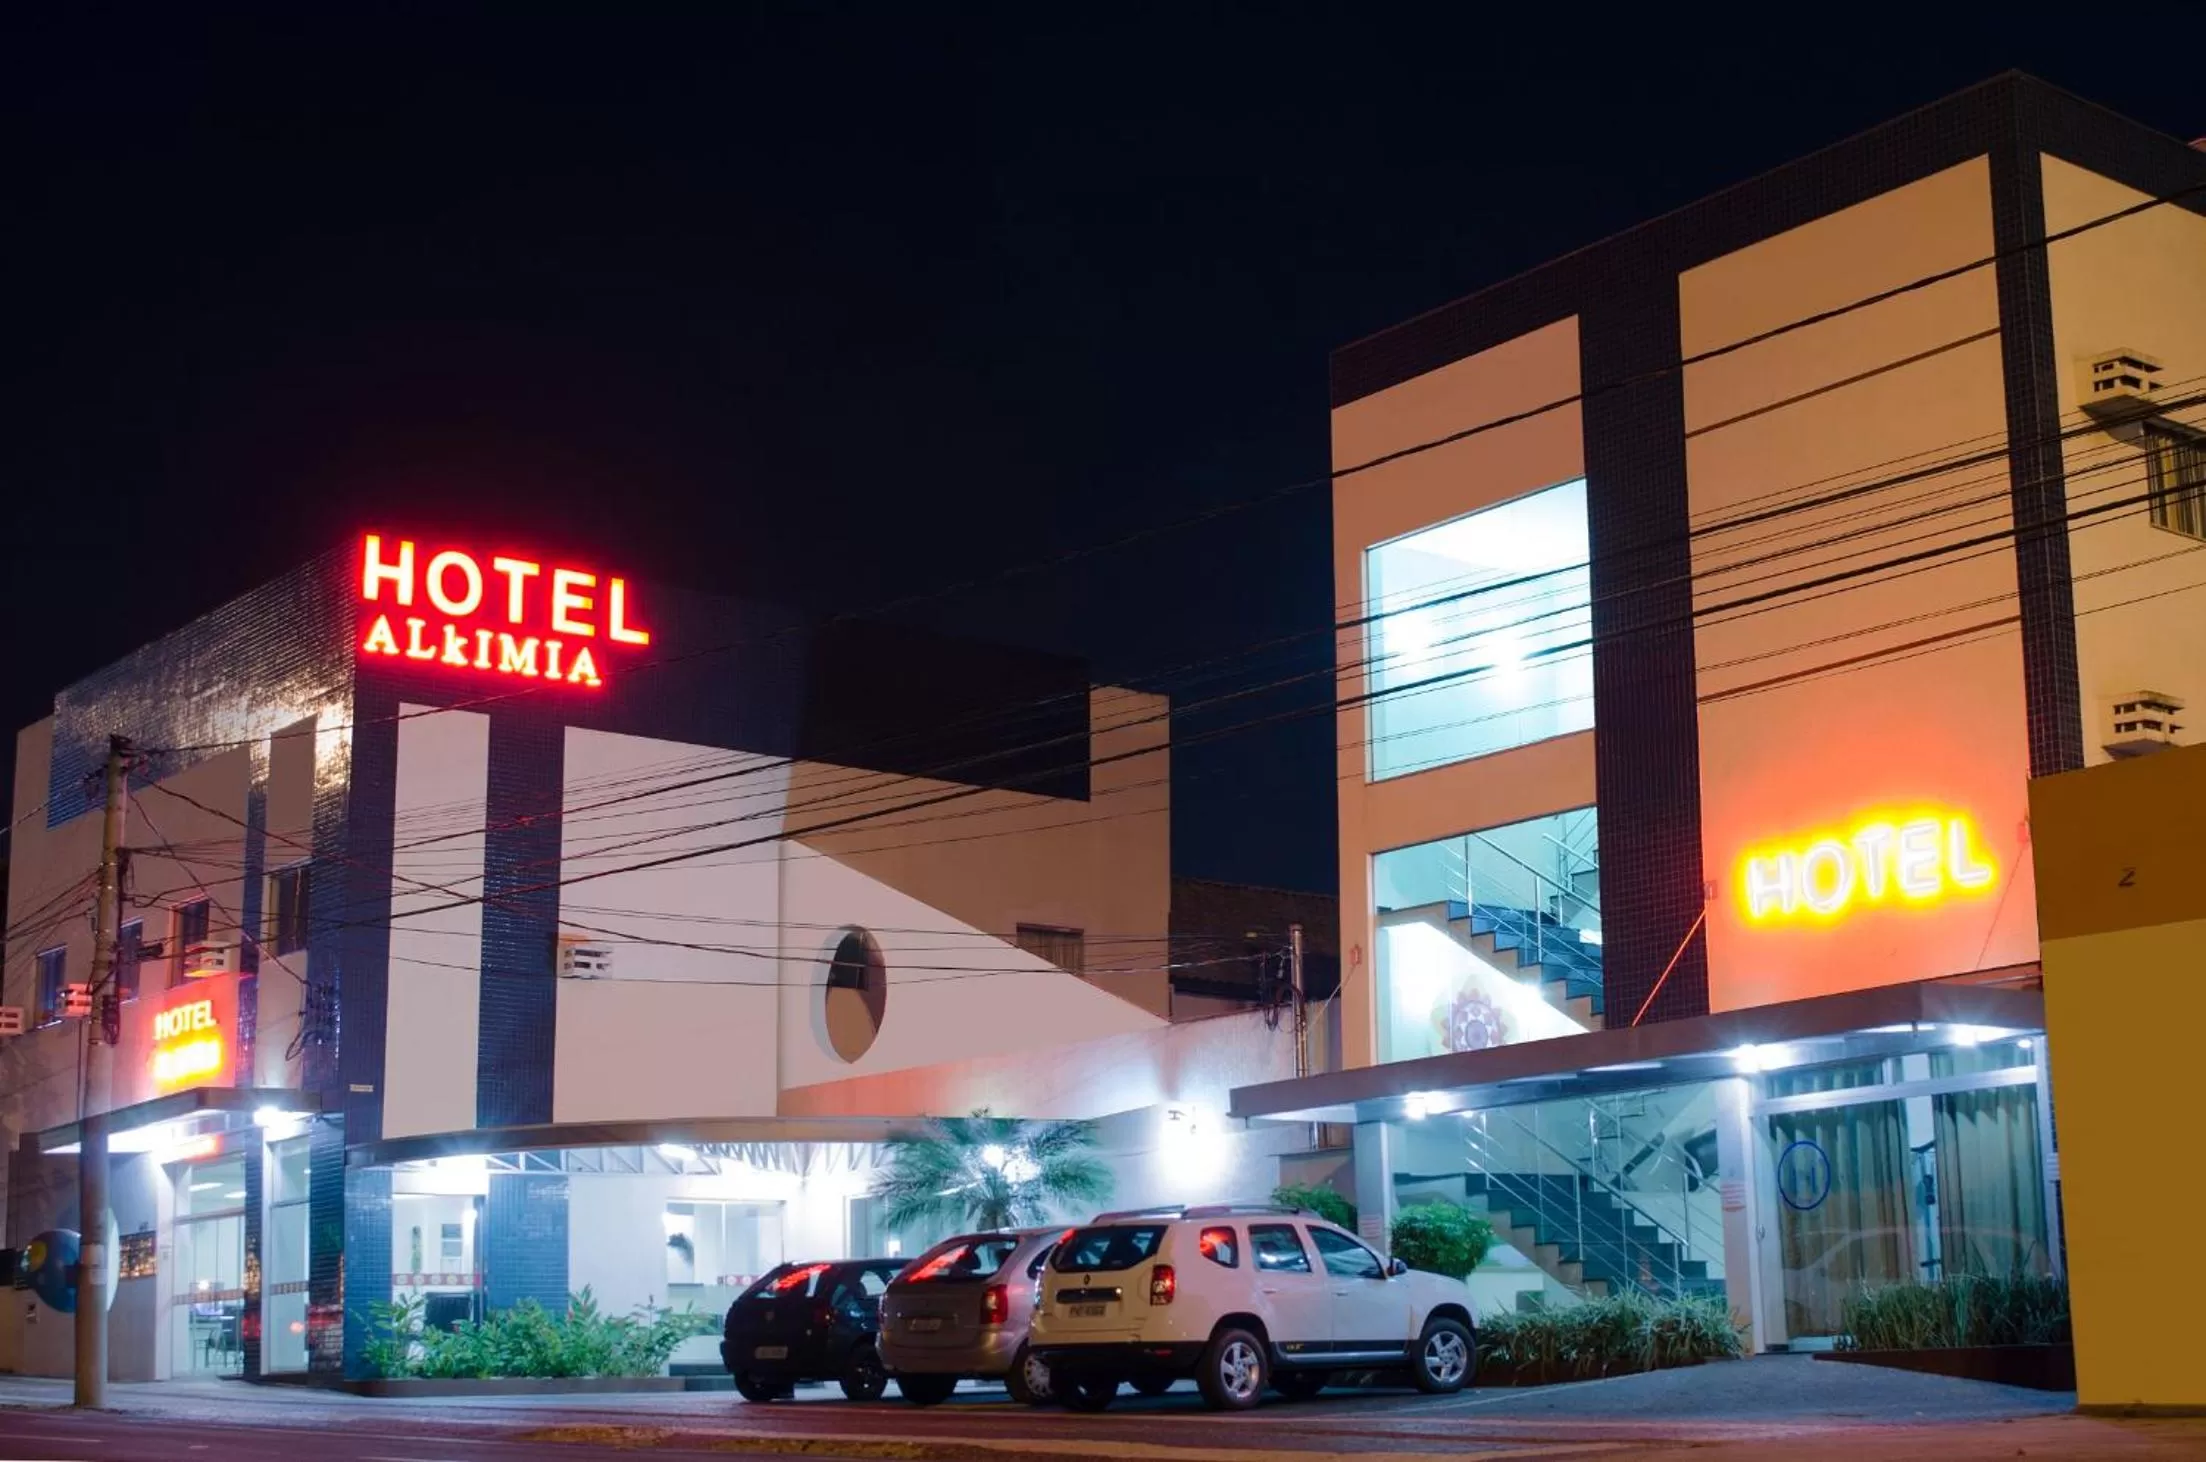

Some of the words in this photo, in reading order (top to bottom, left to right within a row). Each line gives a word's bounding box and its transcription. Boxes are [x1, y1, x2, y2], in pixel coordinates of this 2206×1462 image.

[362, 534, 650, 645] HOTEL
[1747, 818, 1992, 919] HOTEL
[153, 999, 218, 1041] HOTEL
